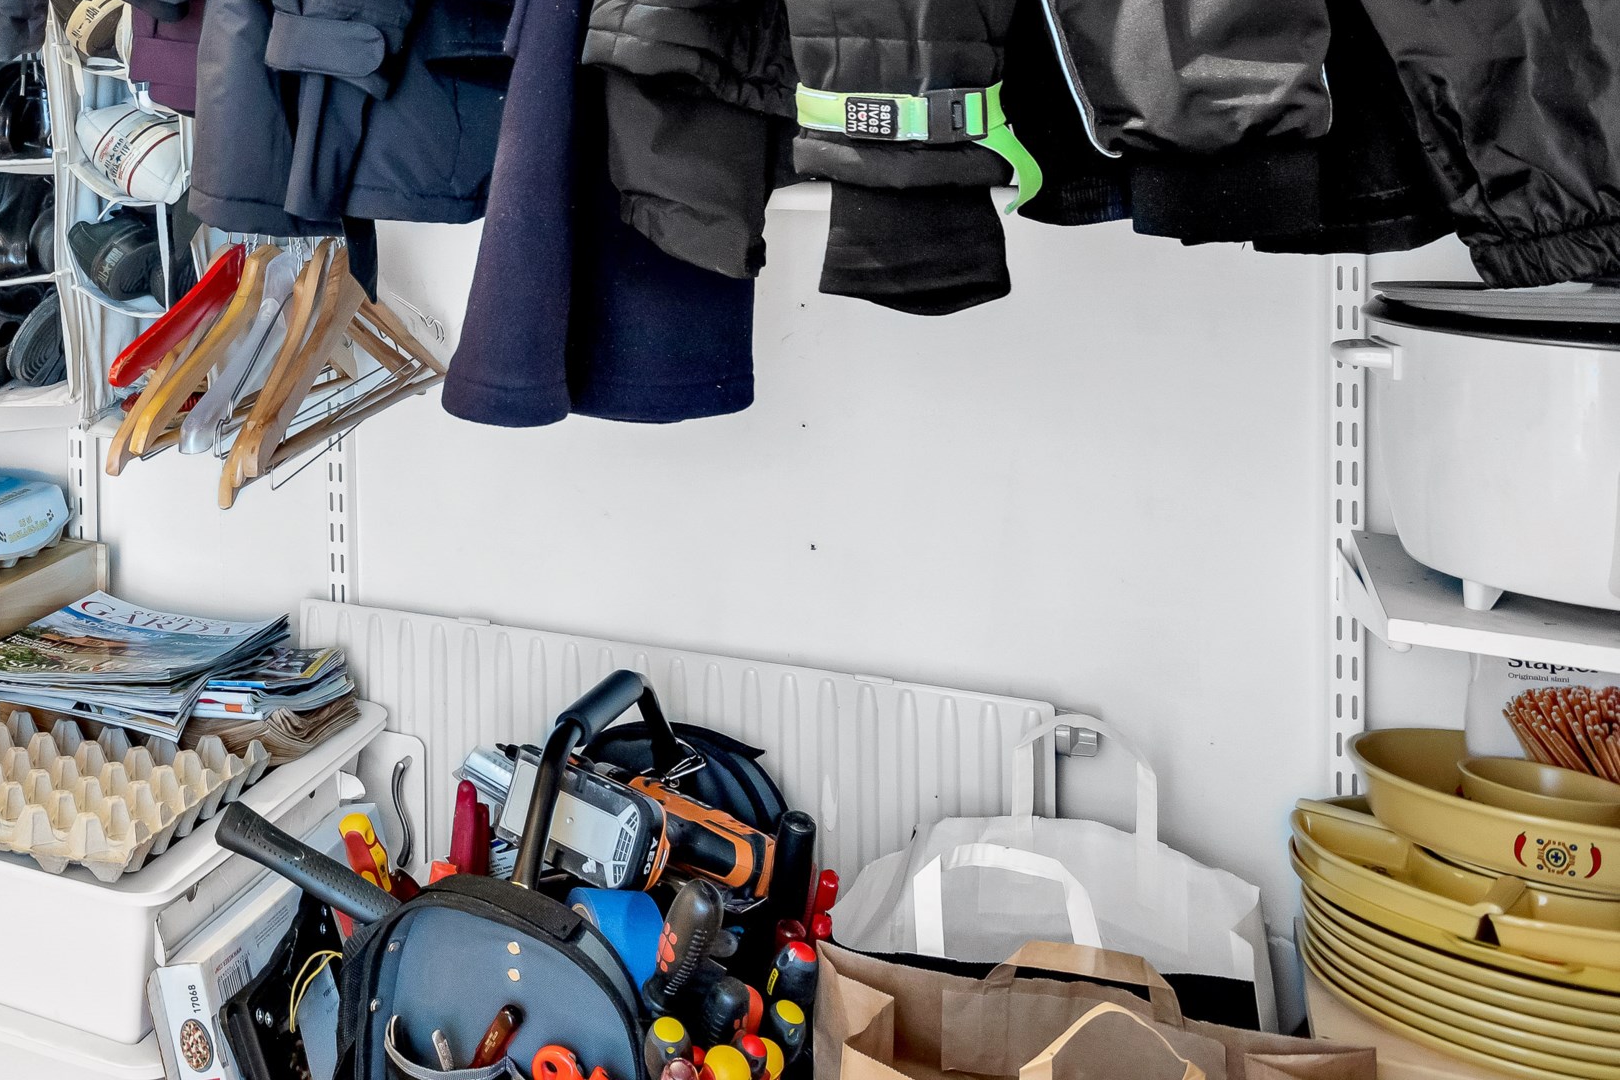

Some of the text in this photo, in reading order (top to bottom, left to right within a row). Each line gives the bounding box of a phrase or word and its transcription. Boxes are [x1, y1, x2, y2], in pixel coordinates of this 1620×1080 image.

[847, 101, 858, 132] .com
[868, 103, 880, 133] lives
[880, 104, 891, 134] save
[1508, 672, 1549, 682] Originalni
[643, 836, 658, 876] AEG
[187, 984, 202, 1014] 17068
